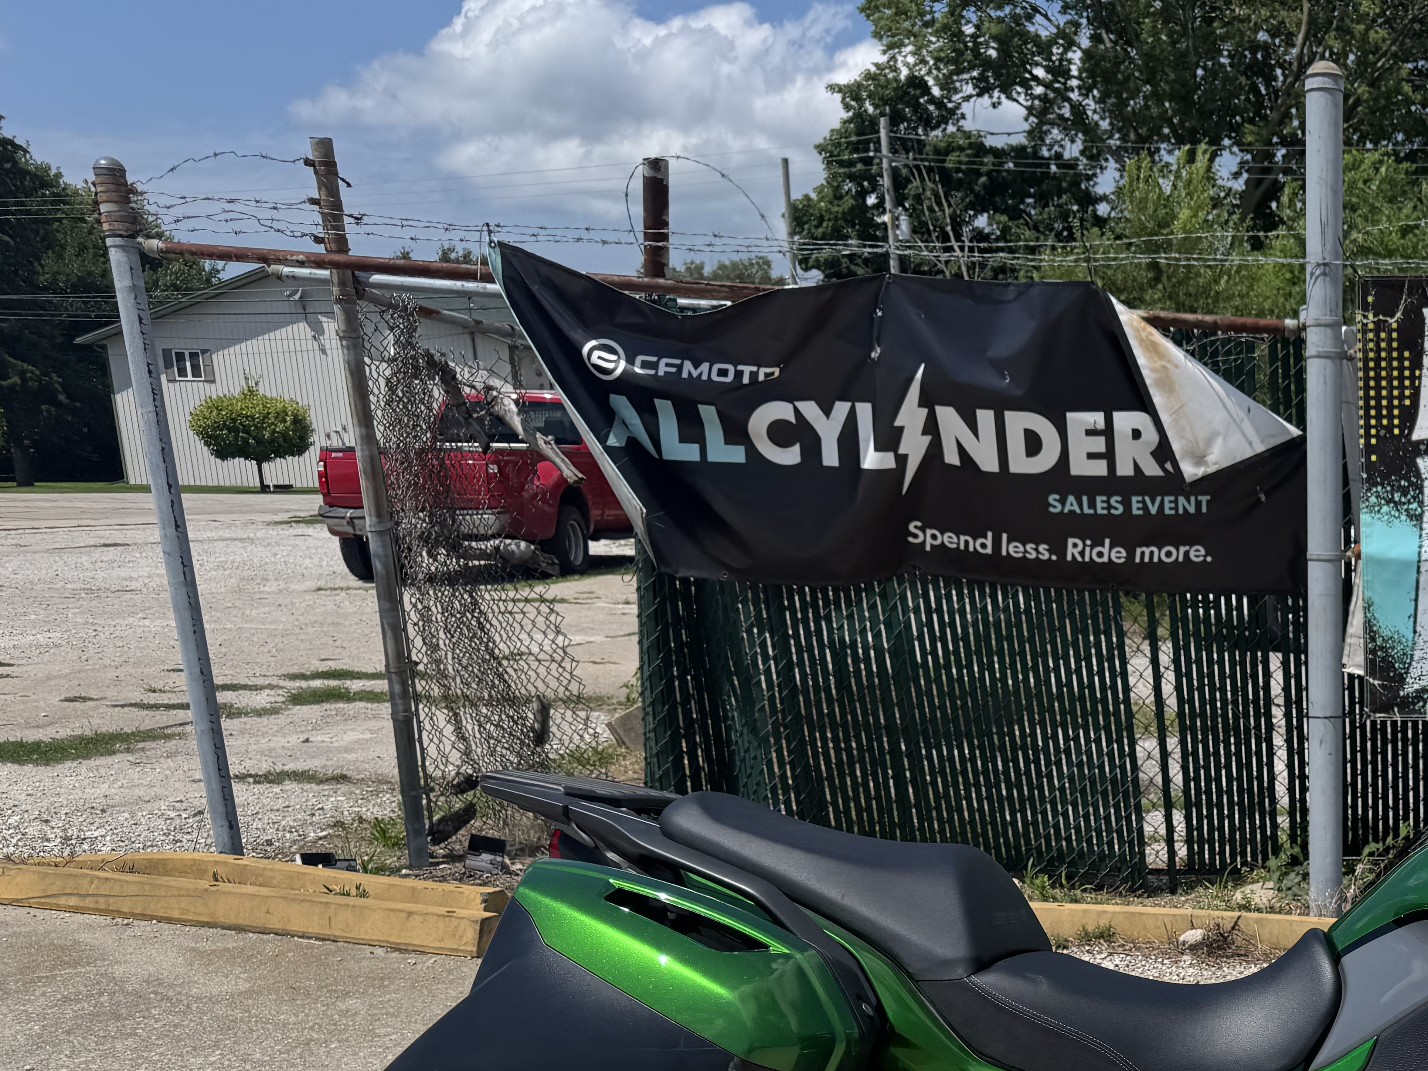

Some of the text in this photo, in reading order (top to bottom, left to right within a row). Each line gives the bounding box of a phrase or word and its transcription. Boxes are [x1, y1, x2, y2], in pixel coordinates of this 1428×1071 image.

[1047, 494, 1212, 515] SALES EVENT
[907, 521, 1213, 564] Spend less. Ride more.
